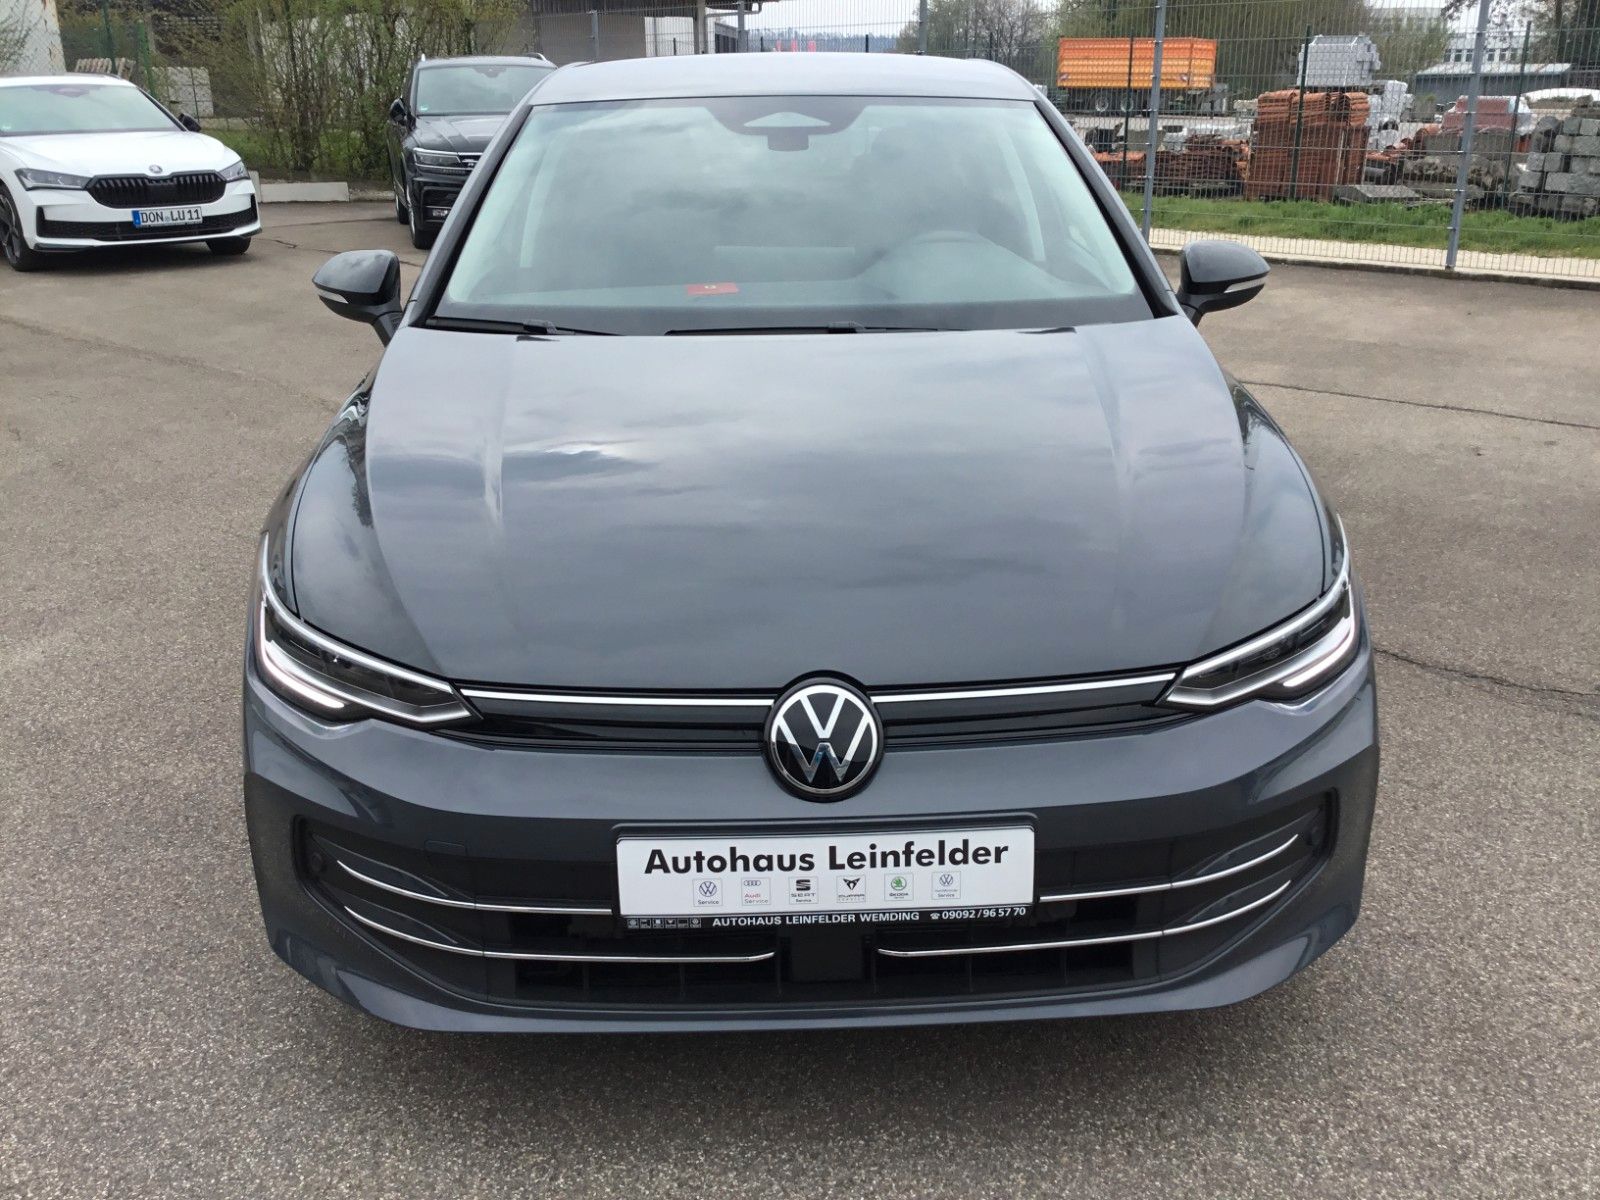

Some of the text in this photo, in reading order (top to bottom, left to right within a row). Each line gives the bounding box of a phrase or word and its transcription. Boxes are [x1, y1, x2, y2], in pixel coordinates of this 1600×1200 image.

[141, 209, 200, 223] DON LU 11
[645, 839, 1009, 874] Autohaus Leinfelder
[712, 916, 782, 927] AUTOHAUS
[785, 913, 856, 925] LEINFELDER
[860, 911, 920, 923] WEMDING
